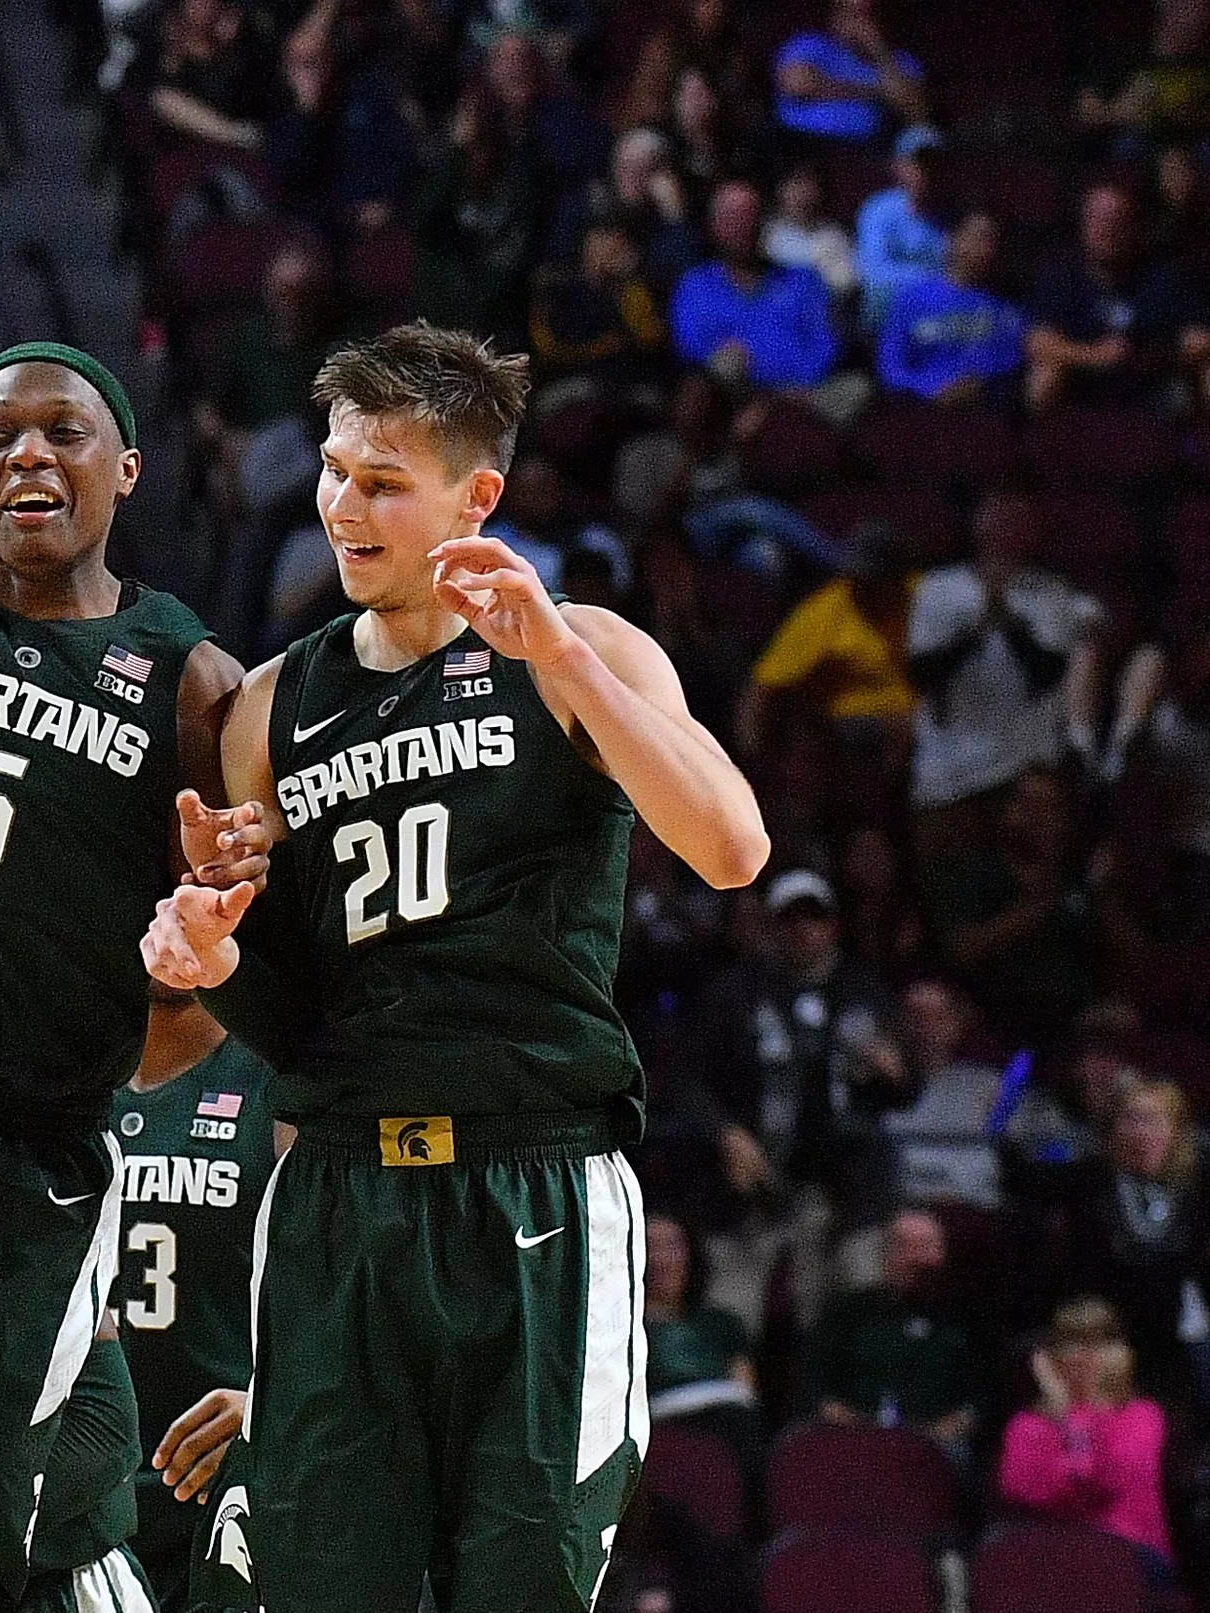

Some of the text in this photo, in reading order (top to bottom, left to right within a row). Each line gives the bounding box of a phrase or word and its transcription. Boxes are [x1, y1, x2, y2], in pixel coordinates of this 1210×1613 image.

[277, 715, 516, 831] SPARTANS
[332, 802, 450, 945] 20
[121, 1155, 241, 1208] TANS
[112, 1222, 177, 1330] 3
